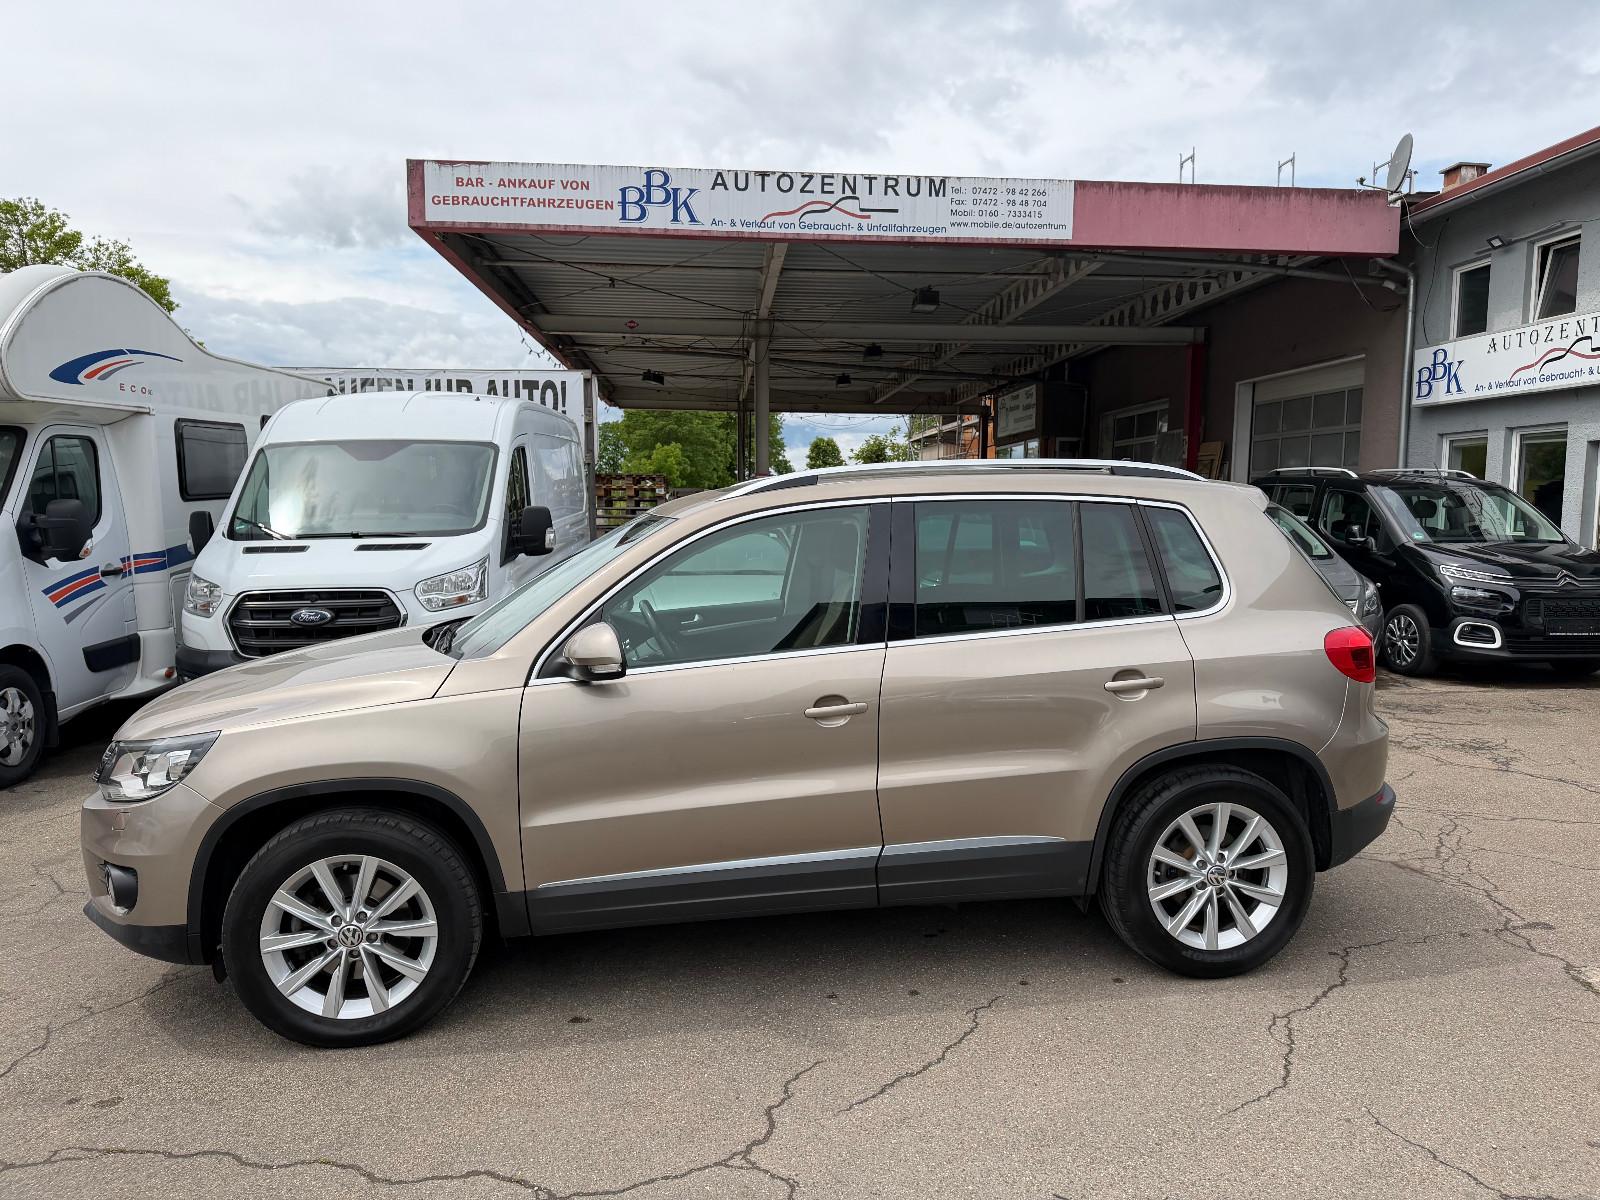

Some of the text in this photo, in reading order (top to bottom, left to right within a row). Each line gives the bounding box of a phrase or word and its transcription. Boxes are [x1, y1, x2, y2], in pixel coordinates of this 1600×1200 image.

[455, 176, 484, 188] BAR
[498, 177, 556, 189] ANKAUF
[560, 179, 590, 191] VON
[710, 171, 947, 197] AUTOZENTRUM
[617, 169, 704, 226] BBK
[972, 187, 998, 196] 07472
[1006, 188, 1016, 196] 98
[1019, 188, 1029, 196] 42
[1031, 188, 1047, 197] 266
[431, 194, 614, 210] GEBRAUCHTFAHRZEUGEN
[950, 198, 967, 206] Fax:
[972, 199, 998, 207] 07472
[1006, 199, 1016, 207] 98
[1018, 199, 1029, 208] 48
[1032, 200, 1047, 208] 704
[950, 209, 976, 217] Mobil:
[978, 209, 999, 218] 0160
[1007, 210, 1043, 219] 7333415
[710, 219, 947, 235] An- & Verkauf von Gebraucht- & Unfallfahrzeugen
[950, 221, 1067, 230] www.mobile.de/autozentrum
[1487, 316, 1600, 354] AUTOZENT
[1416, 348, 1466, 399] BBK
[1494, 377, 1522, 390] Verkauf
[1523, 376, 1537, 386] von
[1588, 366, 1595, 376] &
